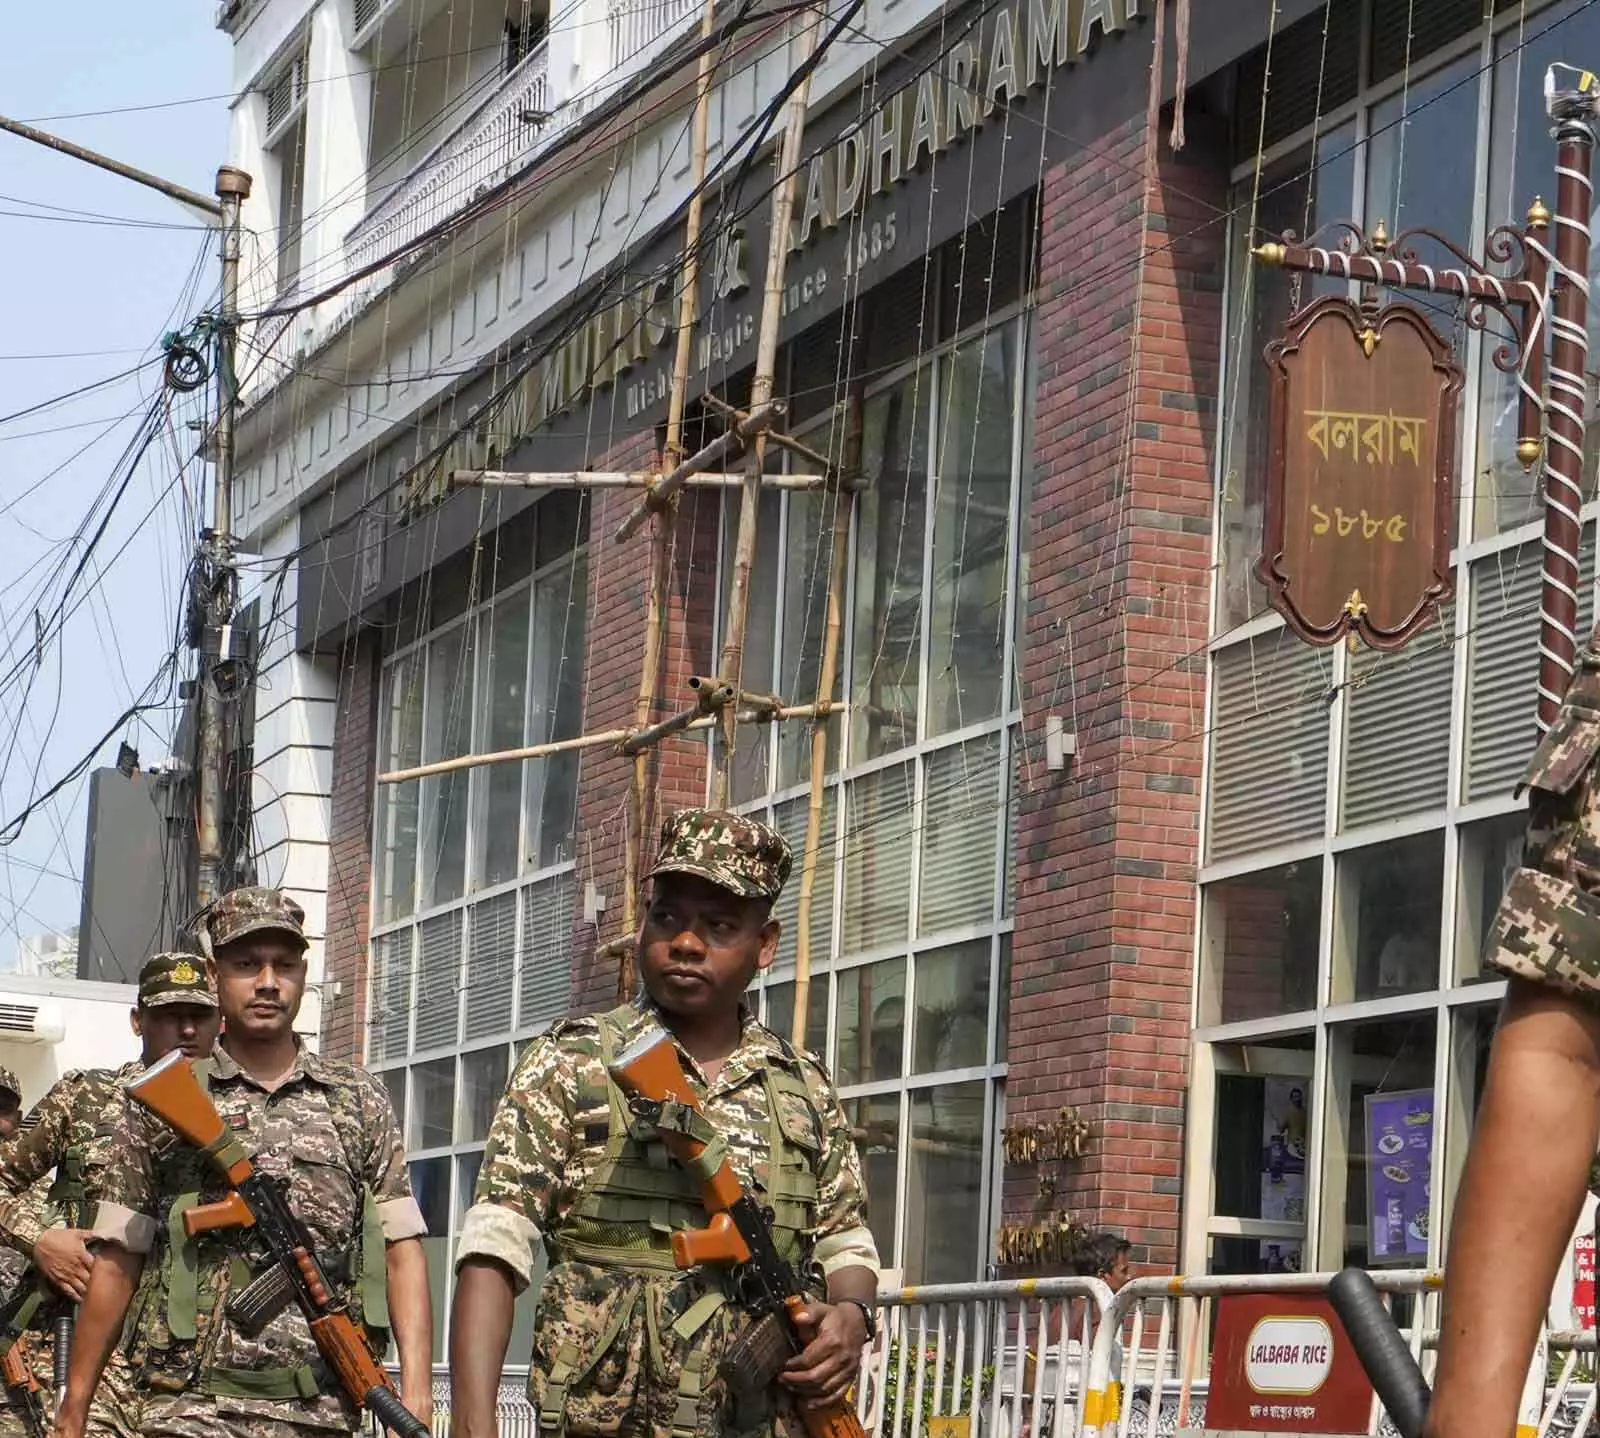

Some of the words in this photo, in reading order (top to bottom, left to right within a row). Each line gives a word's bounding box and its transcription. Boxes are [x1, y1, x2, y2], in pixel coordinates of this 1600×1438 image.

[782, 267, 827, 317] ince
[1303, 407, 1427, 467] বলরাম
[1310, 504, 1408, 543] ১৮৮৫
[1250, 1344, 1299, 1365] LALBABA
[1302, 1344, 1328, 1365] RICE
